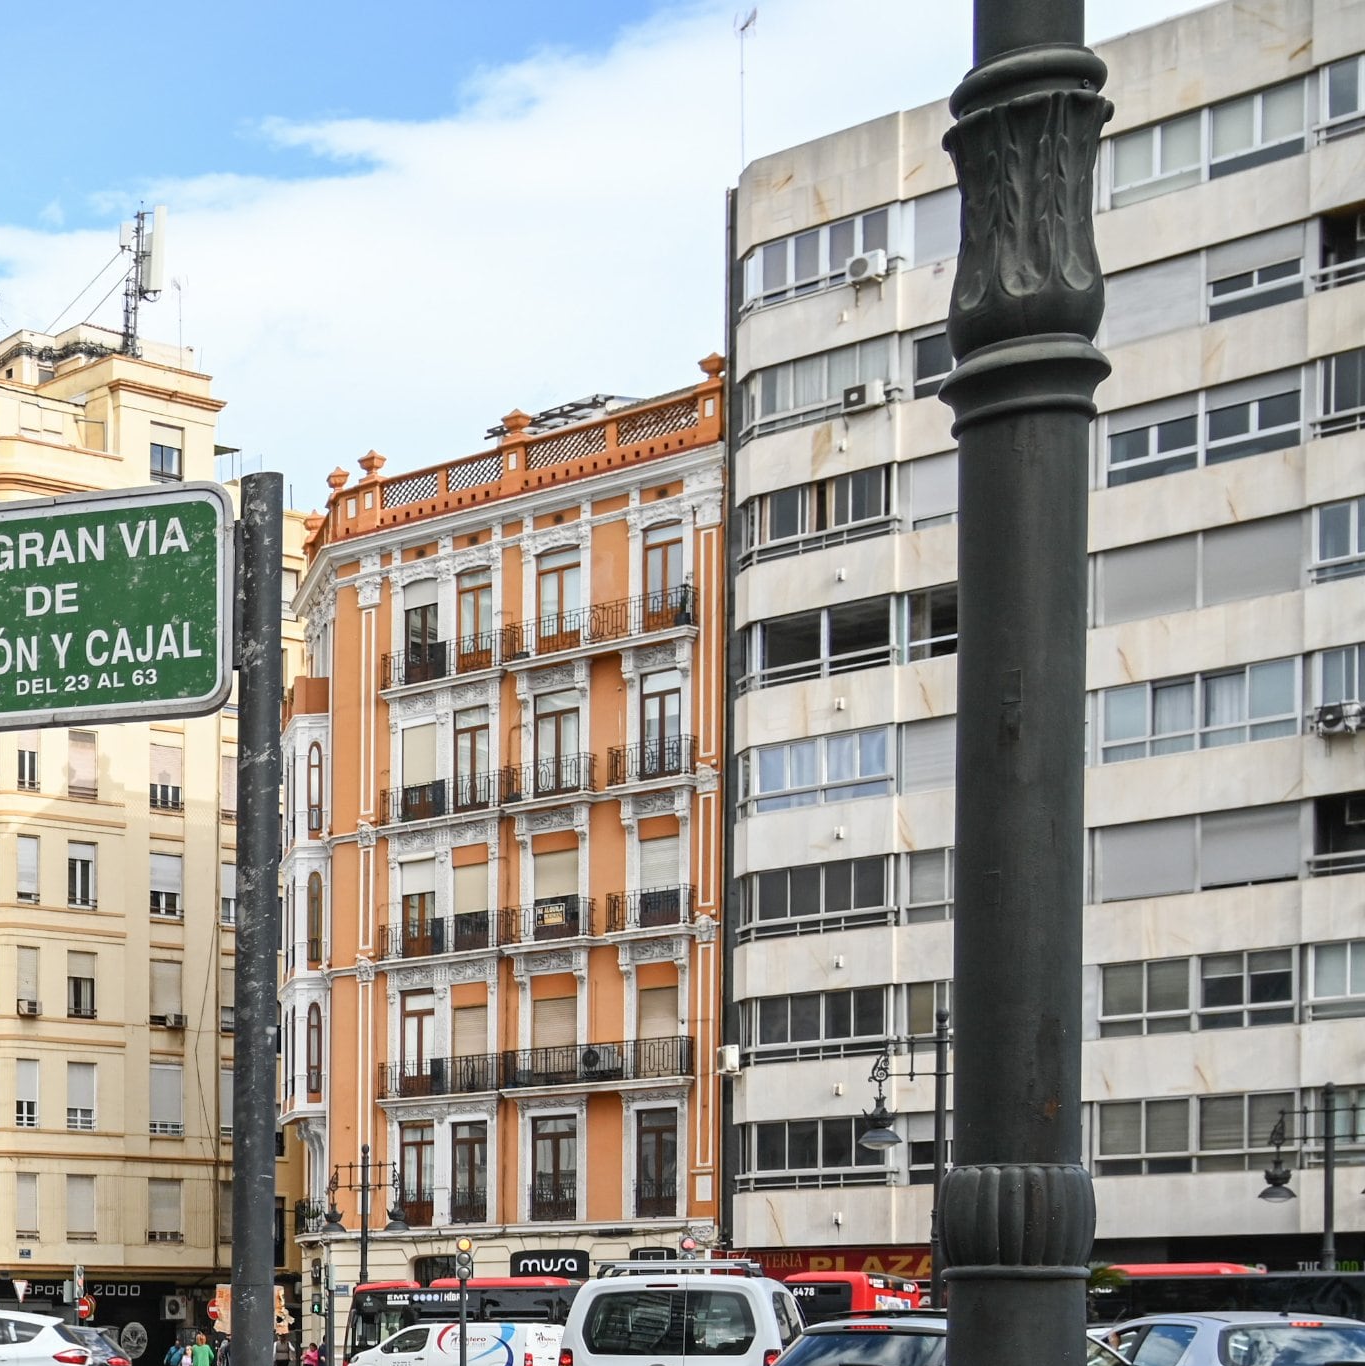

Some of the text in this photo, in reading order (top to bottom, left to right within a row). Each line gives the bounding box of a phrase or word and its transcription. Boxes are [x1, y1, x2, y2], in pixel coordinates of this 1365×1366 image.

[118, 517, 190, 558] VIA
[25, 582, 79, 617] DE
[51, 632, 73, 669] Y
[85, 621, 202, 667] CAJAL
[16, 668, 158, 696] DEL 23 AL 63
[93, 1284, 141, 1297] 2000
[792, 1286, 815, 1297] 6478
